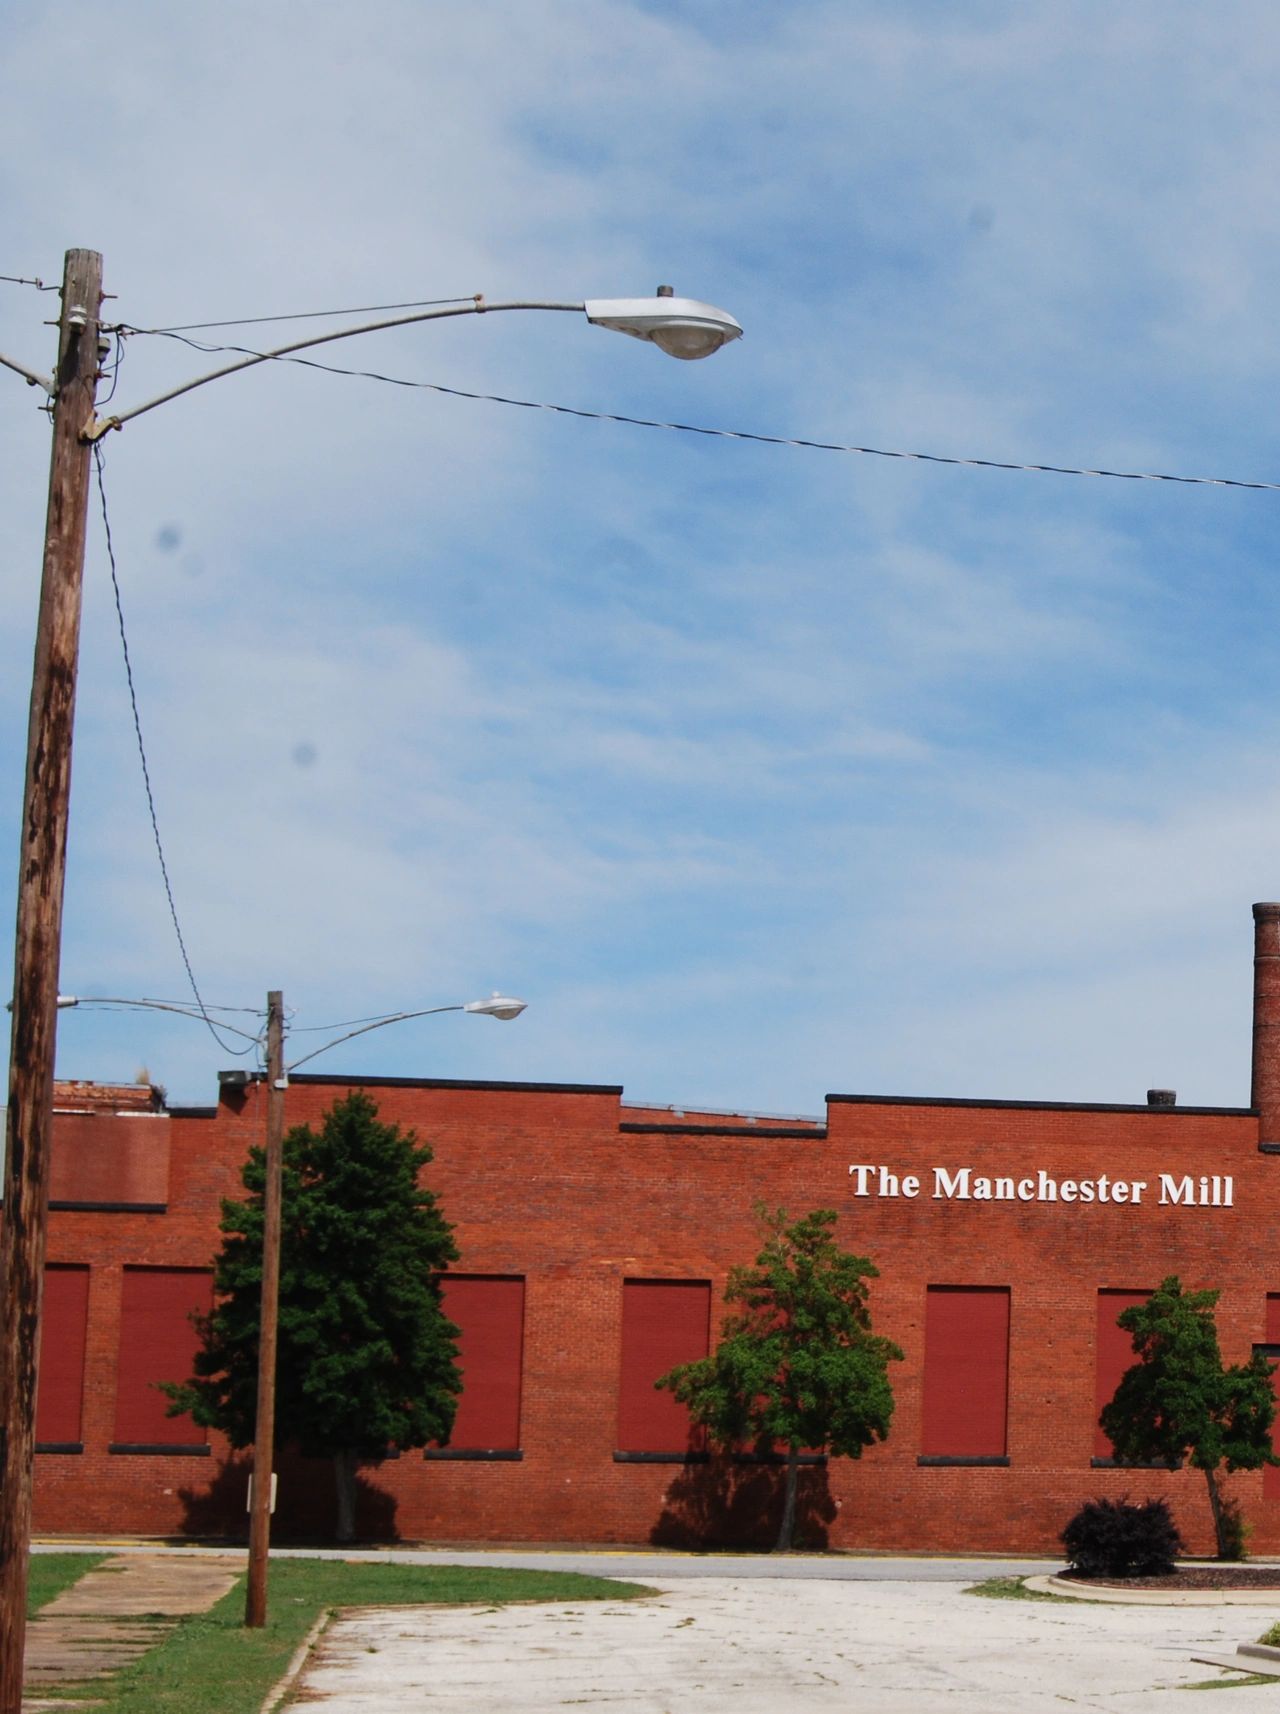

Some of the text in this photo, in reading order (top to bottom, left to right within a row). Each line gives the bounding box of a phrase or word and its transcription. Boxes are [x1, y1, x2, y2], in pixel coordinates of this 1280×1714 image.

[848, 1165, 1235, 1206] The Manchester Mill
